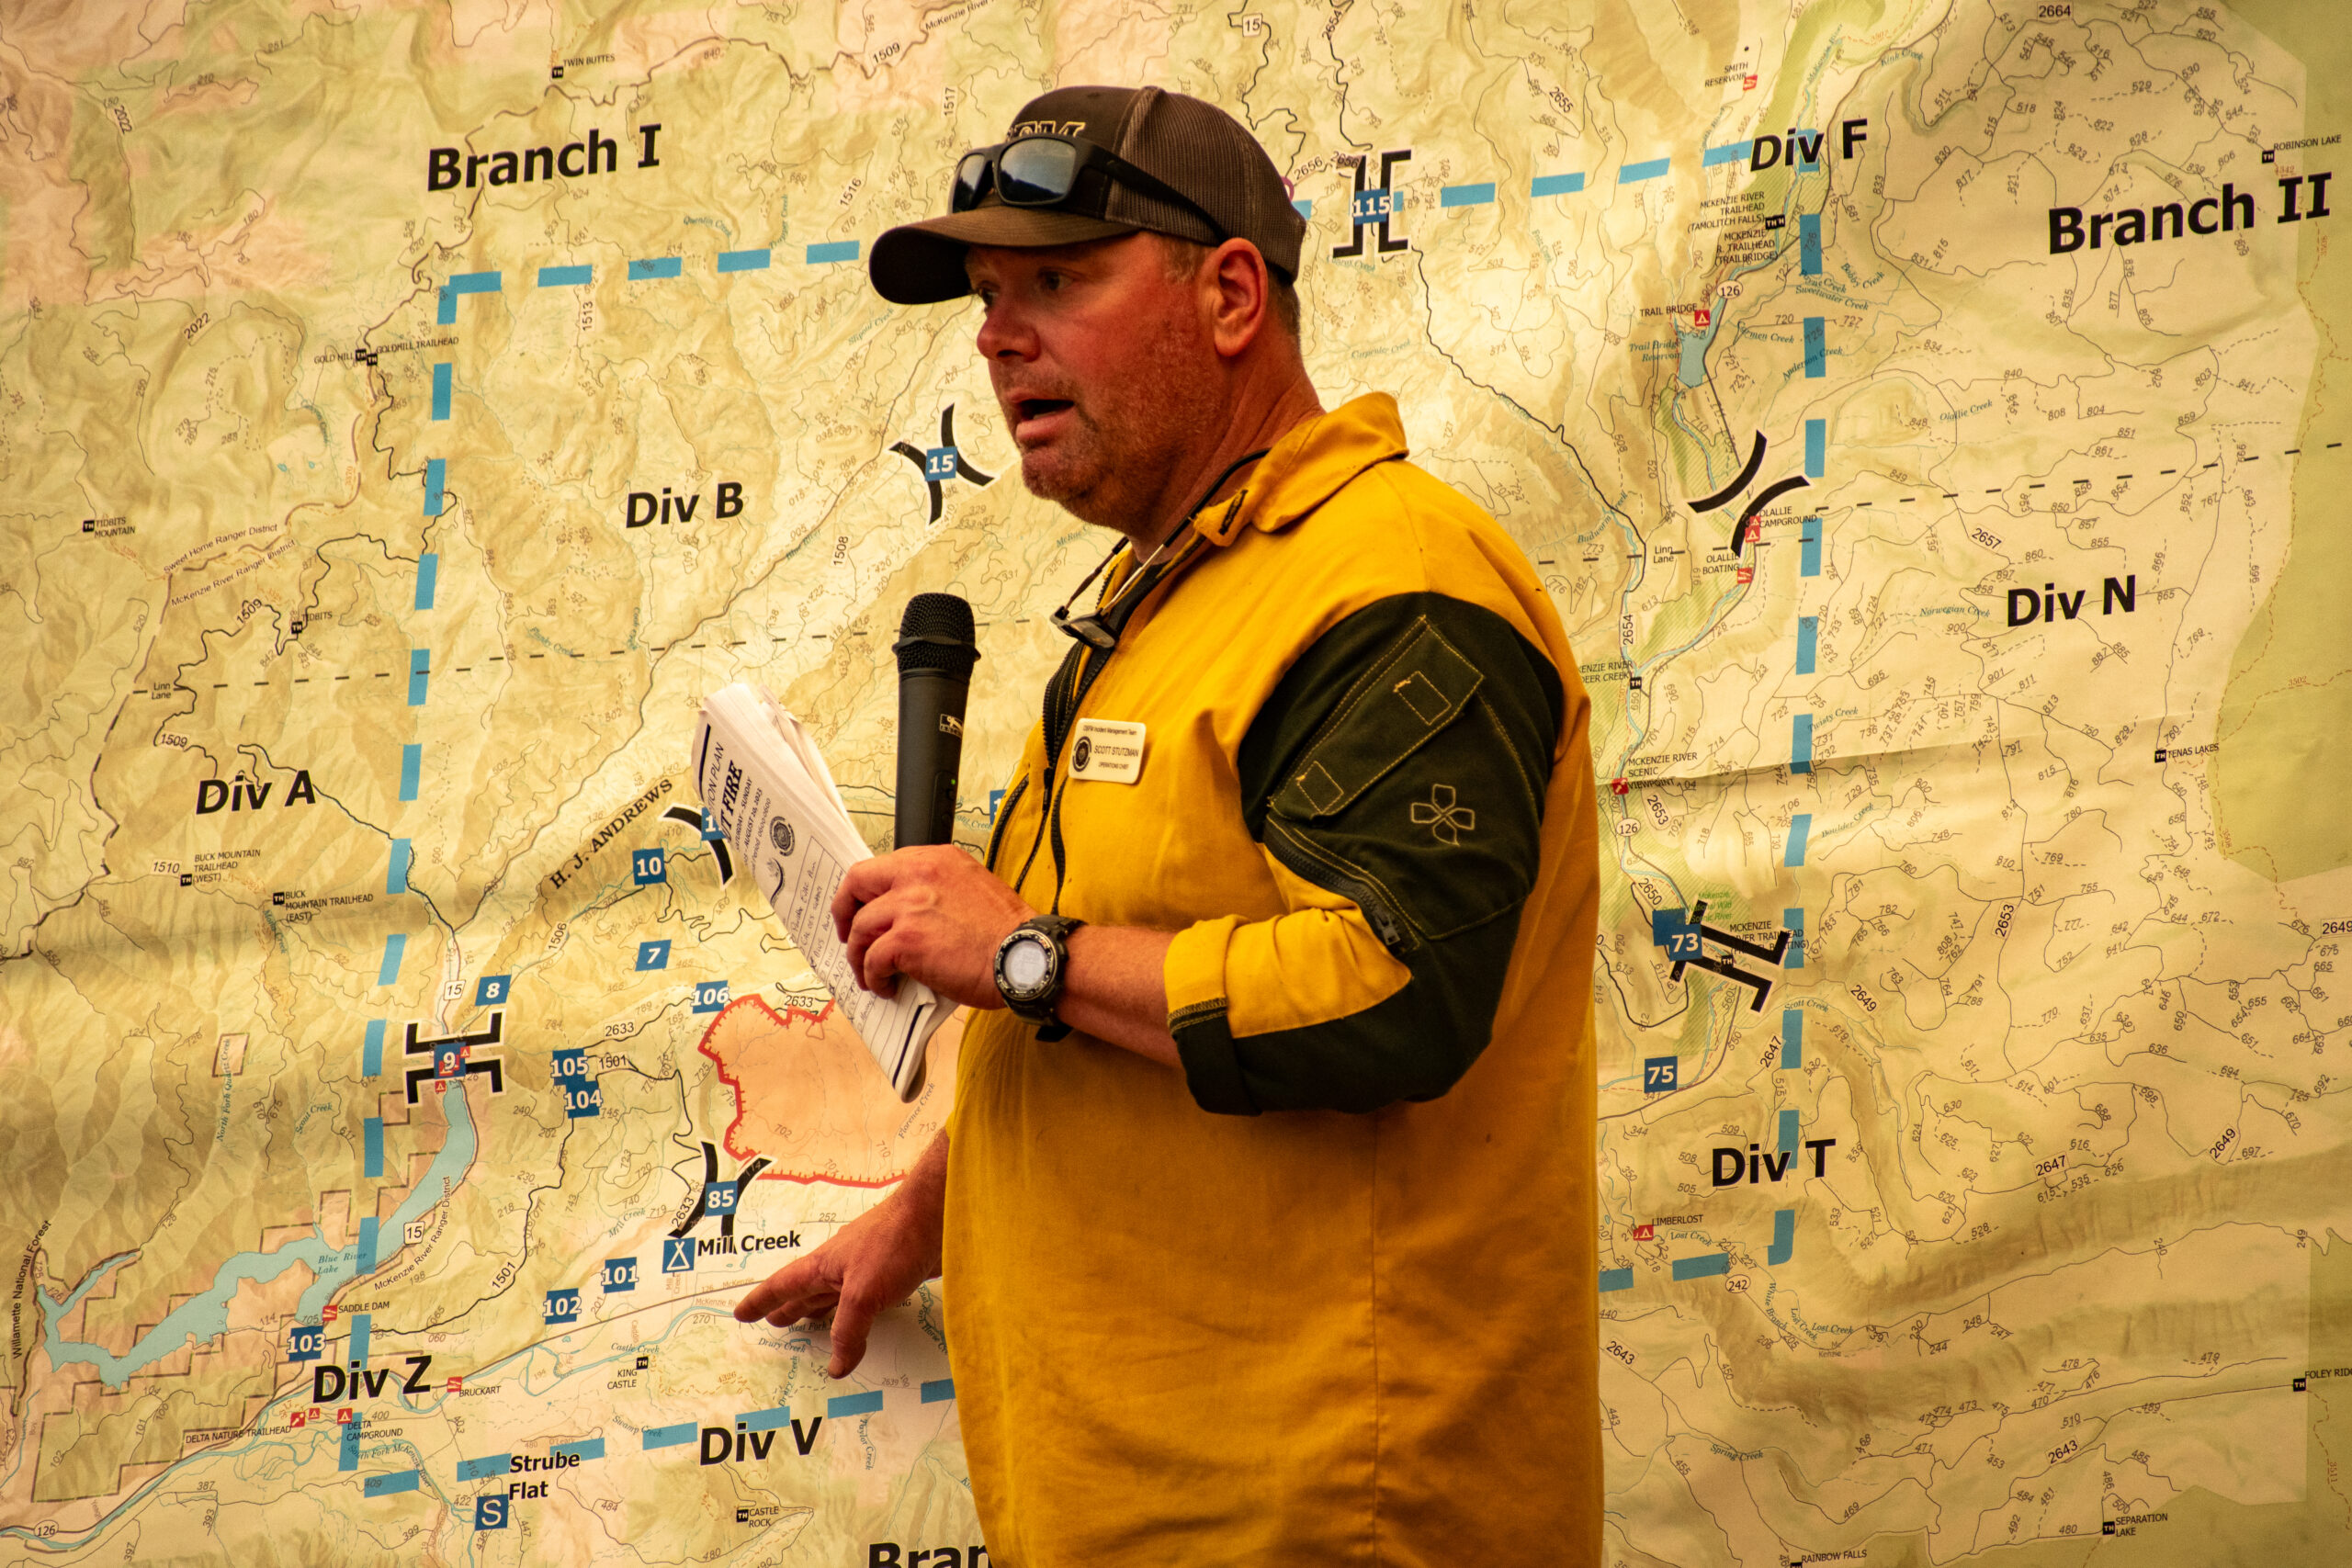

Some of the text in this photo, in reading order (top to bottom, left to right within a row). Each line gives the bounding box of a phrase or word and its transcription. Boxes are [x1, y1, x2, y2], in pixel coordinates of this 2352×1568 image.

[925, 8, 966, 30] McKenzie
[2038, 5, 2072, 18] 2664
[1244, 17, 1261, 33] 15
[1321, 10, 1342, 39] 2654
[563, 53, 615, 67] TWIN BUTTES
[871, 42, 902, 65] 1509
[1724, 62, 1748, 73] SMITH
[1704, 73, 1747, 88] RESERVOIR
[942, 87, 956, 118] 1517
[1548, 86, 1574, 115] 2655
[1749, 119, 1869, 172] Div F
[2273, 134, 2342, 152] ROBINSON LAKE
[427, 123, 662, 193] Branch I
[1294, 156, 1324, 181] 2656
[839, 177, 863, 208] 1516
[1700, 191, 1765, 209] MCKENZIE RIVER
[1351, 195, 1392, 219] 115
[1721, 202, 1765, 216] TRAILHEAD
[2049, 171, 2333, 255] Branch II
[1721, 286, 1741, 297] 126
[1639, 303, 1697, 317] TRAIL BRIDGE
[184, 311, 213, 342] 2022
[414, 335, 459, 350] TRAILHEAD
[928, 454, 955, 474] 15
[626, 480, 745, 529] Div B
[95, 516, 128, 528] TIDBITS
[1758, 514, 1818, 529] CAMPGROUND
[94, 525, 136, 537] MOUNTAIN
[1971, 527, 2003, 549] 2657
[832, 535, 849, 568] 1508
[1654, 545, 1673, 555] Linn
[1653, 554, 1675, 565] Lane
[2007, 574, 2137, 628] Div N
[235, 598, 264, 625] 1509
[1919, 604, 1992, 618] Norwegian Creek
[1608, 660, 1633, 670] RIVER
[151, 690, 172, 701] Lane
[153, 682, 172, 693] Linn
[160, 733, 188, 749] 1509
[1628, 752, 1698, 766] MCKENZIE RIVER
[2167, 743, 2221, 760] TENAS LAKES
[1628, 766, 1658, 778] SCENIC
[196, 768, 317, 816] Div A
[721, 759, 742, 817] FIRE
[1628, 778, 1674, 790] VIEWPOINT
[1646, 794, 1669, 826] 2653
[549, 778, 673, 890] H. J. ANDREWS
[1619, 822, 1639, 835] 126
[194, 849, 261, 863] BUCK MOUNTAIN
[153, 861, 180, 874] 1510
[193, 861, 238, 873] TRAILHEAD
[637, 856, 662, 877] 10
[193, 873, 221, 884] (WEST)
[285, 890, 306, 900] BUCK
[1638, 877, 1663, 907] 2650
[285, 893, 374, 911] MOUNTAIN TRAILHEAD
[286, 912, 313, 923] (EAST)
[1729, 920, 1772, 932] MCKENZIE
[1994, 903, 2016, 939] 2653
[548, 921, 568, 952] 1506
[1670, 932, 1700, 953] 73
[647, 948, 661, 964] 7
[446, 982, 464, 998] 15
[486, 982, 501, 998] 8
[690, 986, 729, 1008] 106
[1849, 984, 1878, 1013] 2649
[785, 995, 815, 1008] 2633
[605, 1021, 636, 1037] 2633
[1758, 1034, 1783, 1067] 2647
[442, 1052, 456, 1070] 9
[550, 1056, 589, 1078] 105
[599, 1055, 628, 1070] 1501
[1646, 1066, 1675, 1085] 75
[564, 1089, 604, 1111] 104
[2208, 1127, 2239, 1160] 2649
[1711, 1137, 1837, 1189] Div T
[2034, 1154, 2068, 1177] 2647
[707, 1189, 735, 1209] 85
[1651, 1213, 1704, 1226] LIMBERLOST
[373, 1175, 452, 1292] McKenzie River Ranger District
[405, 1225, 423, 1240] 15
[696, 1230, 801, 1257] Mill Creek
[491, 1260, 517, 1289] 1501
[602, 1265, 639, 1286] 101
[11, 1219, 52, 1360] Willamette National Forest
[1727, 1279, 1749, 1292] 242
[338, 1301, 390, 1314] SADDLE DAM
[541, 1295, 582, 1317] 102
[693, 1314, 711, 1325] 270
[286, 1333, 325, 1355] 103
[1605, 1339, 1636, 1367] 2643
[313, 1355, 433, 1405] Div Z
[617, 1368, 638, 1379] KING
[2304, 1370, 2332, 1380] FOLEY
[459, 1385, 502, 1398] BRUCKART
[607, 1379, 637, 1390] CASTLE
[186, 1425, 292, 1444] DELTA NATURE TRAILHEAD
[346, 1427, 403, 1442] CAMPGROUND
[347, 1420, 372, 1431] DELTA
[700, 1416, 823, 1466] Div V
[2046, 1438, 2080, 1464] 2643
[509, 1450, 581, 1473] Strube
[508, 1481, 549, 1502] Flat
[481, 1499, 503, 1527] S
[749, 1506, 779, 1517] CASTLE
[2115, 1513, 2169, 1526] SEPARATION
[37, 1523, 57, 1536] 126
[749, 1518, 772, 1529] ROCK
[2115, 1526, 2137, 1538] LAKE
[1801, 1549, 1868, 1563] RAINBOW FALLS
